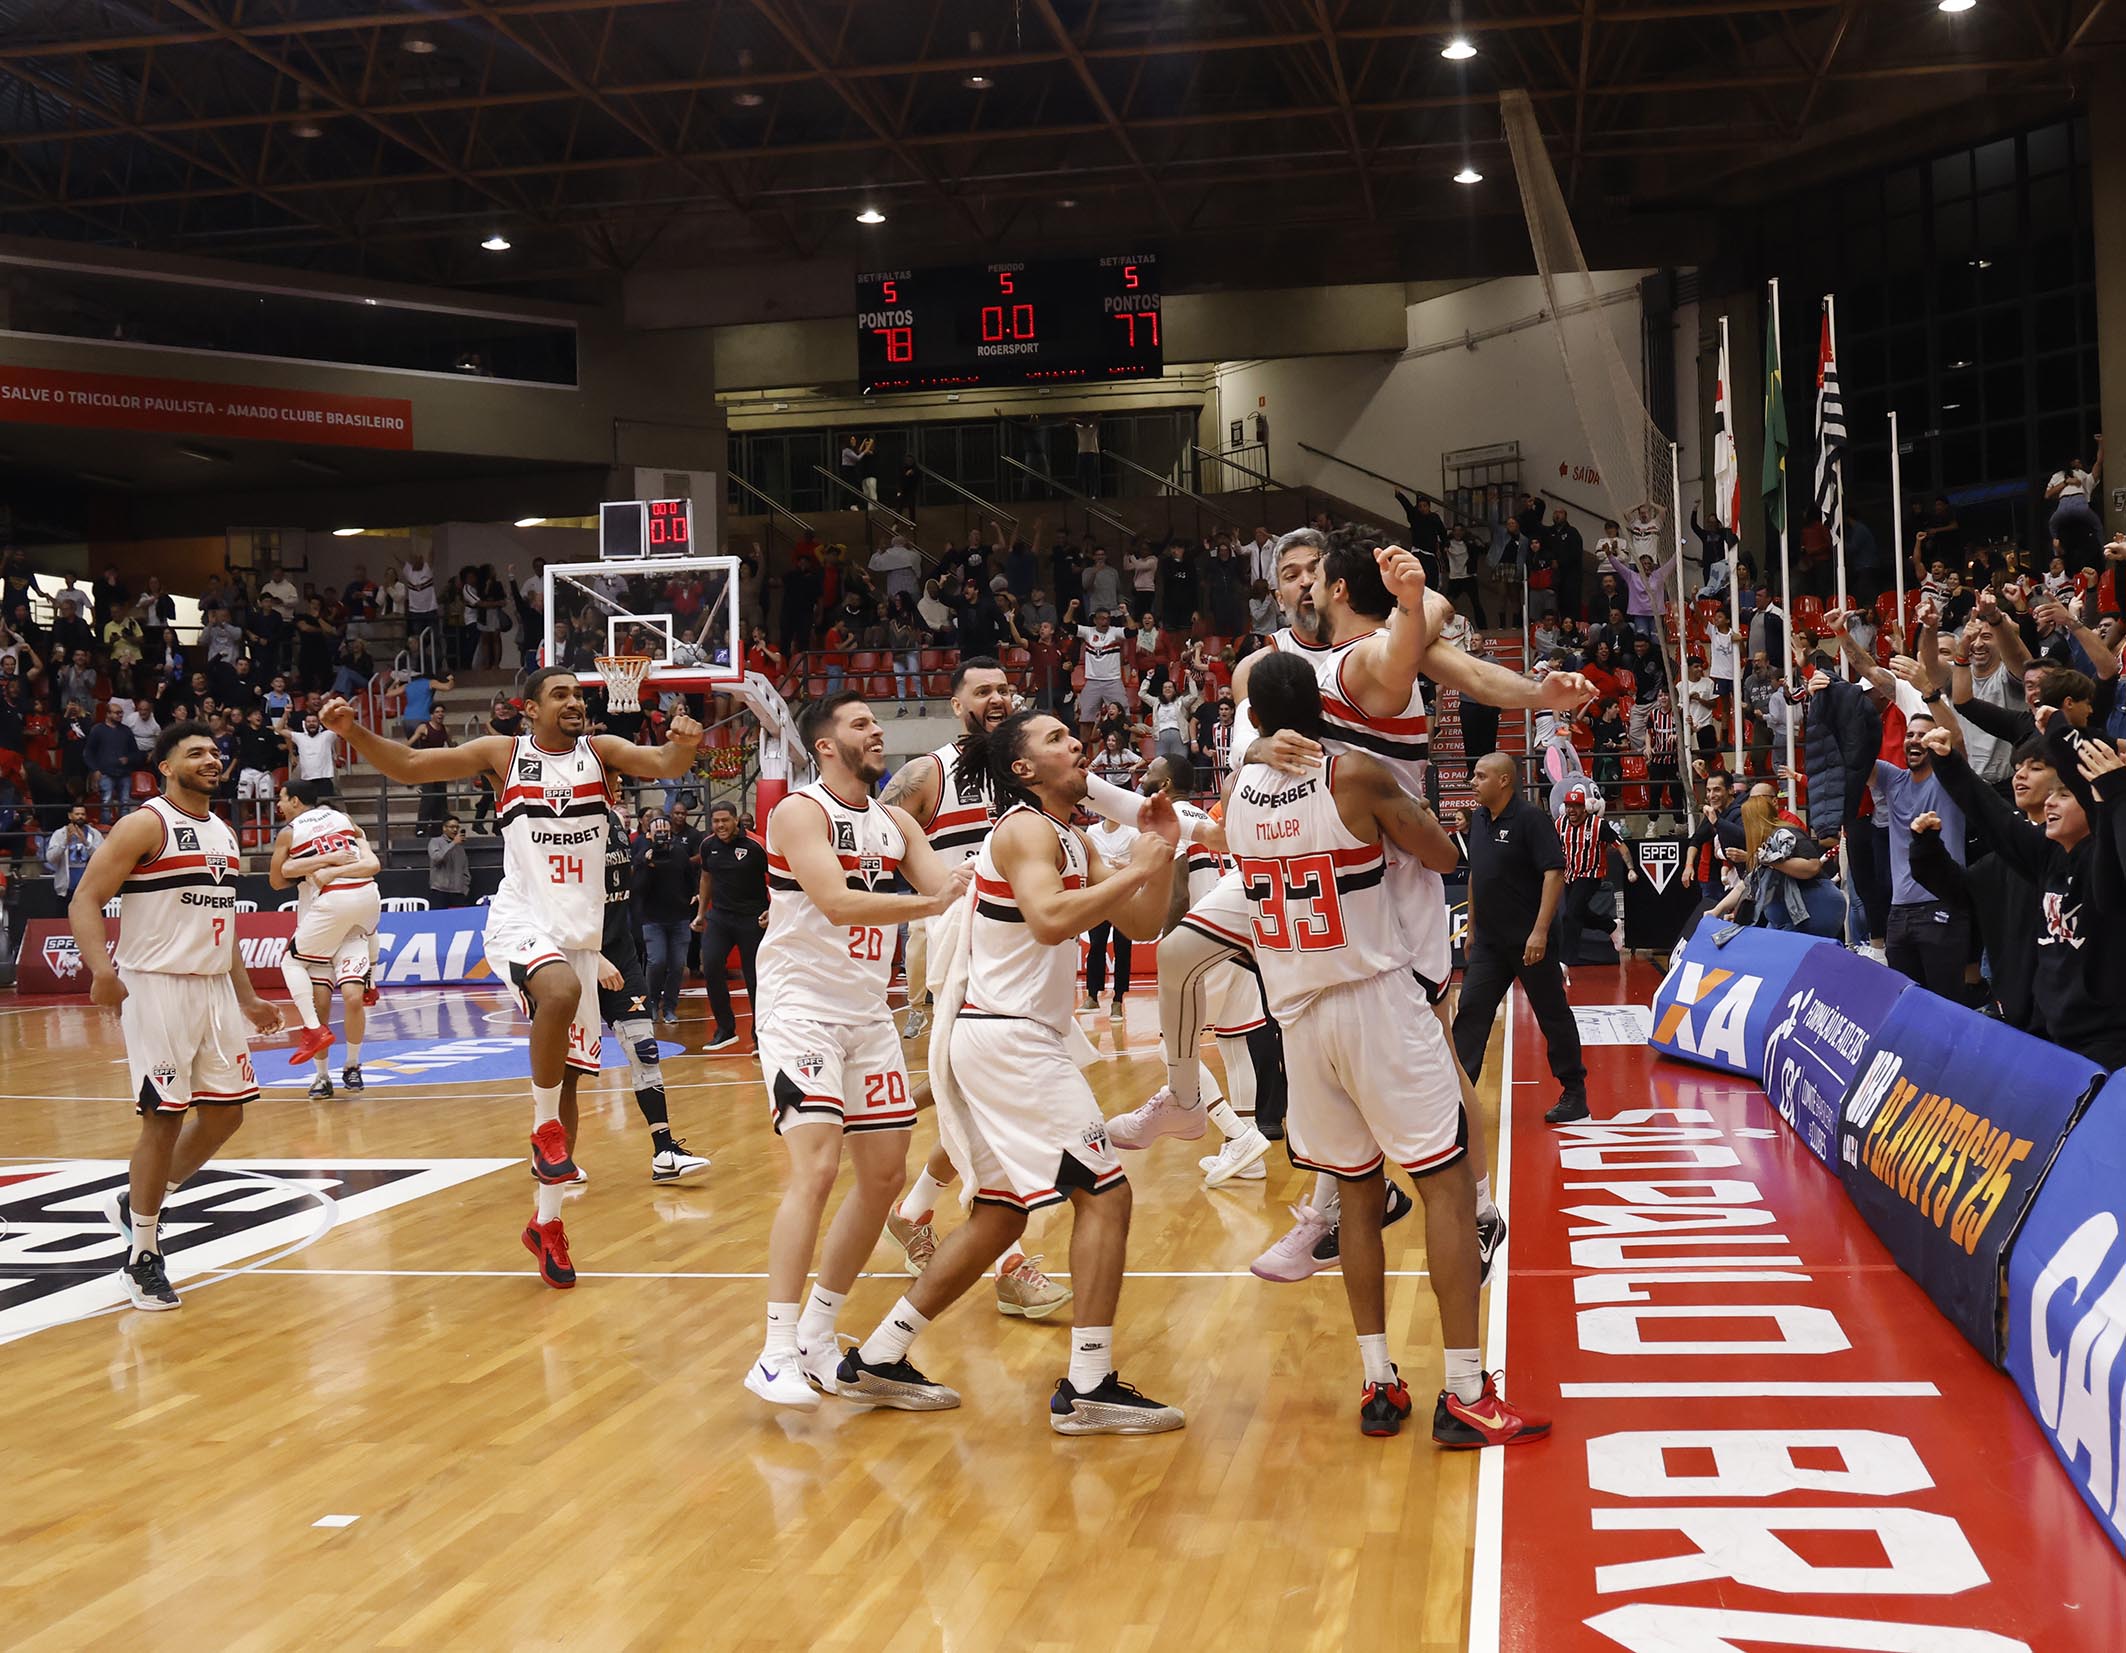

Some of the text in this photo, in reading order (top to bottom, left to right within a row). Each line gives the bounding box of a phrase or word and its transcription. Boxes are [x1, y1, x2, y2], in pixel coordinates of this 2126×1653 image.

[999, 272, 1014, 295] 5
[1125, 266, 1139, 289] 5
[883, 281, 897, 304] 5
[1104, 294, 1161, 313] PONTOS
[858, 309, 914, 329] PONTOS
[1114, 311, 1159, 348] 77
[872, 327, 913, 362] 78
[977, 342, 1040, 357] ROGERSPORT
[1, 385, 51, 402] SALVE
[54, 390, 65, 403] O
[68, 391, 141, 409] TRICOLOR
[145, 397, 215, 415] PAULISTA
[227, 403, 278, 420] AMADO
[281, 408, 323, 423] CLUBE
[327, 412, 405, 430] BRASILEIRO
[1572, 465, 1601, 486] SAÍDA
[650, 516, 688, 545] 0.0
[1240, 778, 1318, 809] SUPERBET
[1255, 818, 1301, 841] MILLER
[1641, 846, 1678, 860] SPFC
[548, 854, 584, 884] 34
[612, 869, 621, 888] 9
[1240, 852, 1349, 952] 33
[212, 918, 225, 947] 7
[847, 926, 884, 961] 20
[1801, 998, 1844, 1046] FORMAÇÃO
[1834, 1019, 1871, 1066] ATLETAS
[864, 1070, 907, 1108] 20
[1551, 1108, 1780, 1171] SÃO
[1557, 1179, 1853, 1355] PAULO
